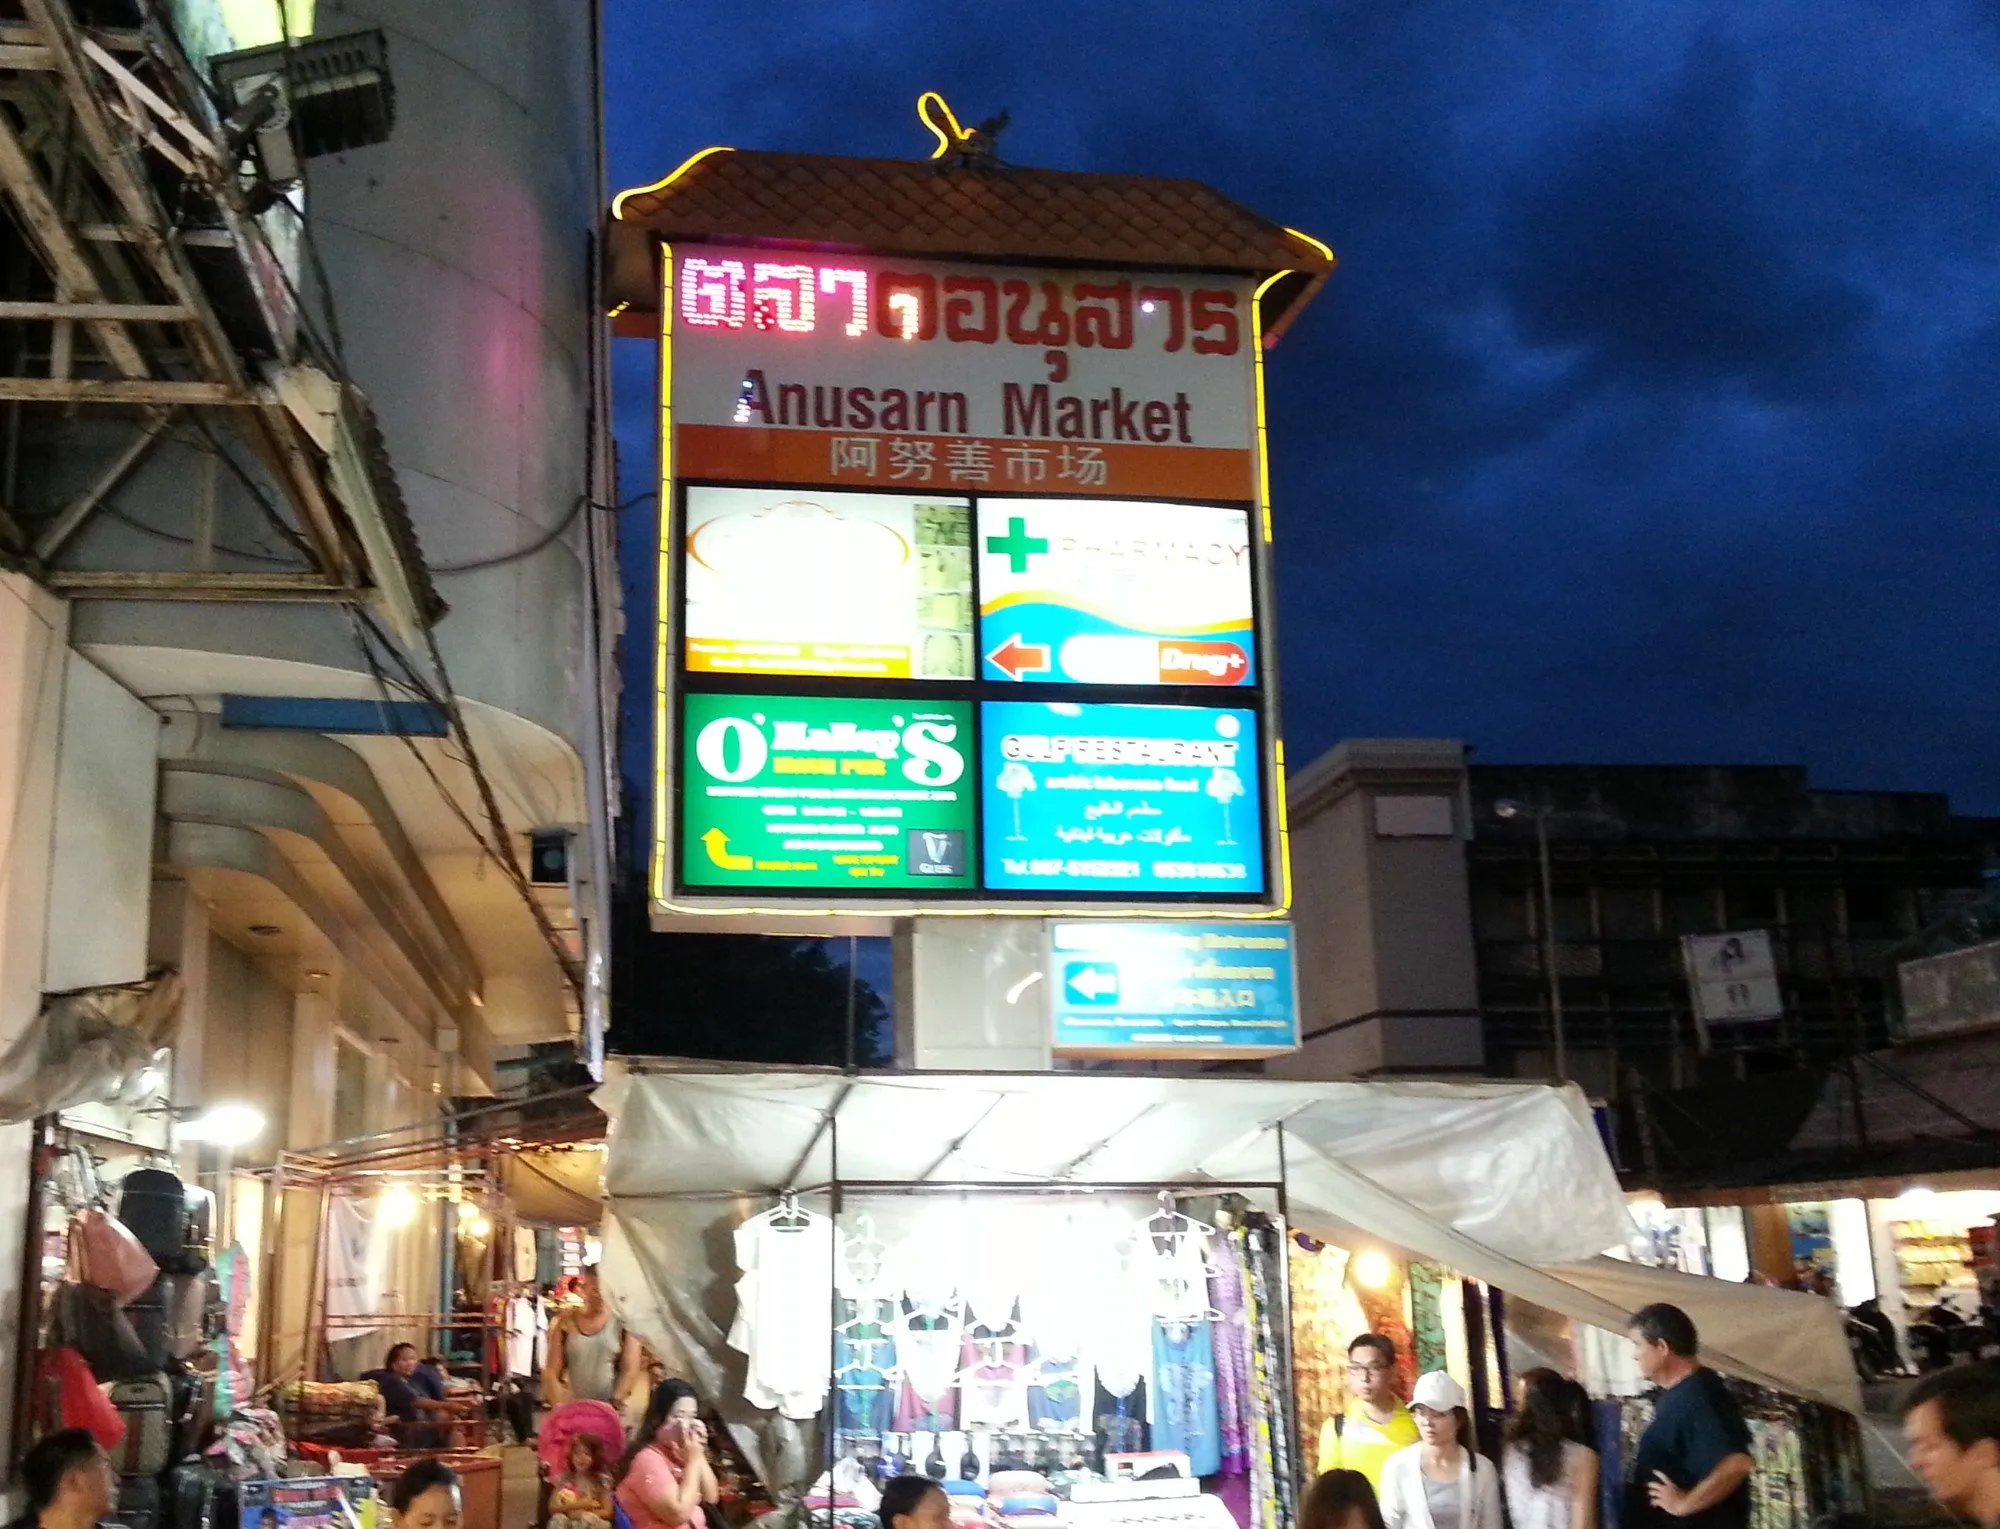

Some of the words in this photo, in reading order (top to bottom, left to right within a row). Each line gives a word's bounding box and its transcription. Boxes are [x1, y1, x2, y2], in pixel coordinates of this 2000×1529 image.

[734, 369, 968, 435] Anusarn
[1004, 382, 1193, 444] Market
[831, 436, 1108, 486] 阿努善市场
